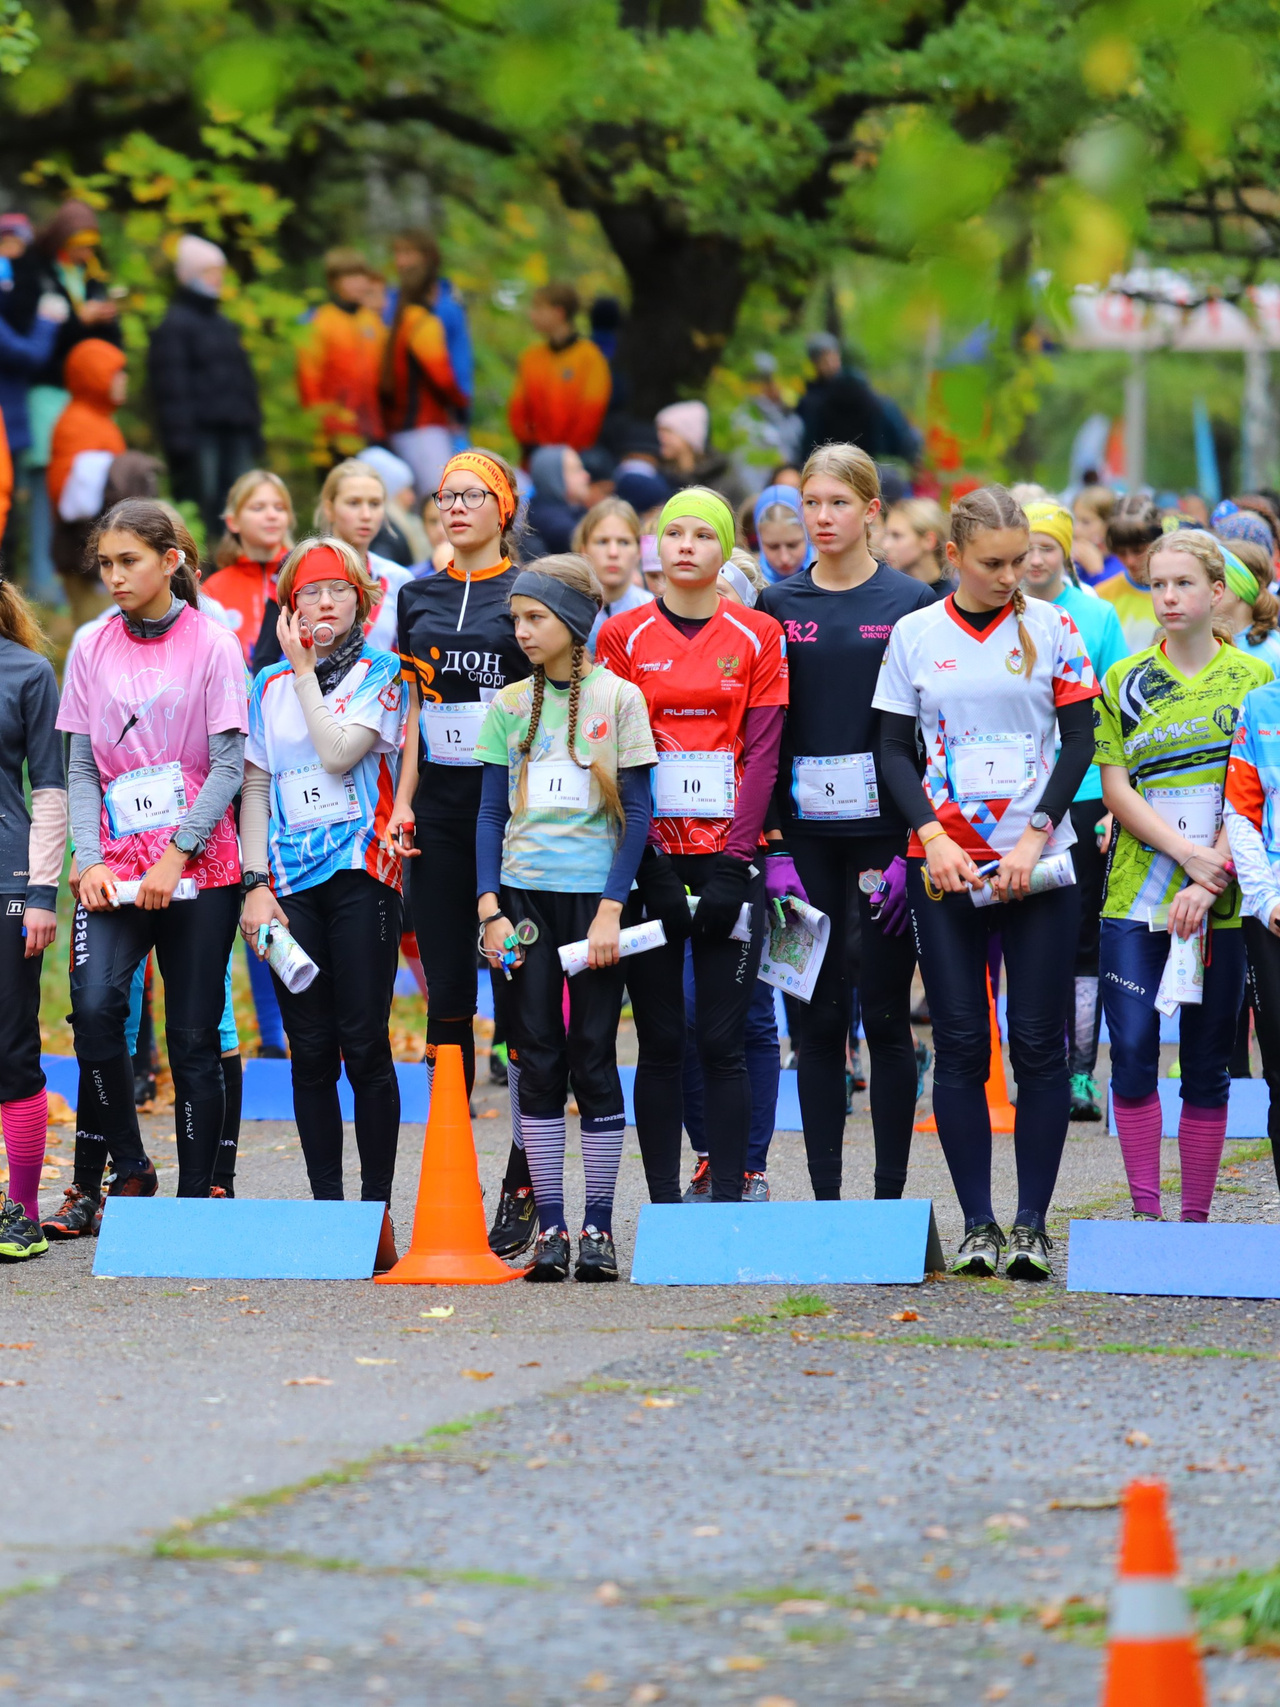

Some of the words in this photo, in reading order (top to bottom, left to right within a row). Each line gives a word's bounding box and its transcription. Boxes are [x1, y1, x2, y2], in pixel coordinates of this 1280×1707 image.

[441, 651, 503, 675] ДОН
[468, 671, 506, 688] спорт
[446, 730, 462, 743] 12
[985, 762, 994, 776] 7
[549, 778, 562, 792] 11
[682, 779, 700, 794] 10
[825, 782, 834, 797] 8
[303, 787, 320, 804] 15
[134, 795, 152, 812] 16
[1178, 816, 1186, 830] 6
